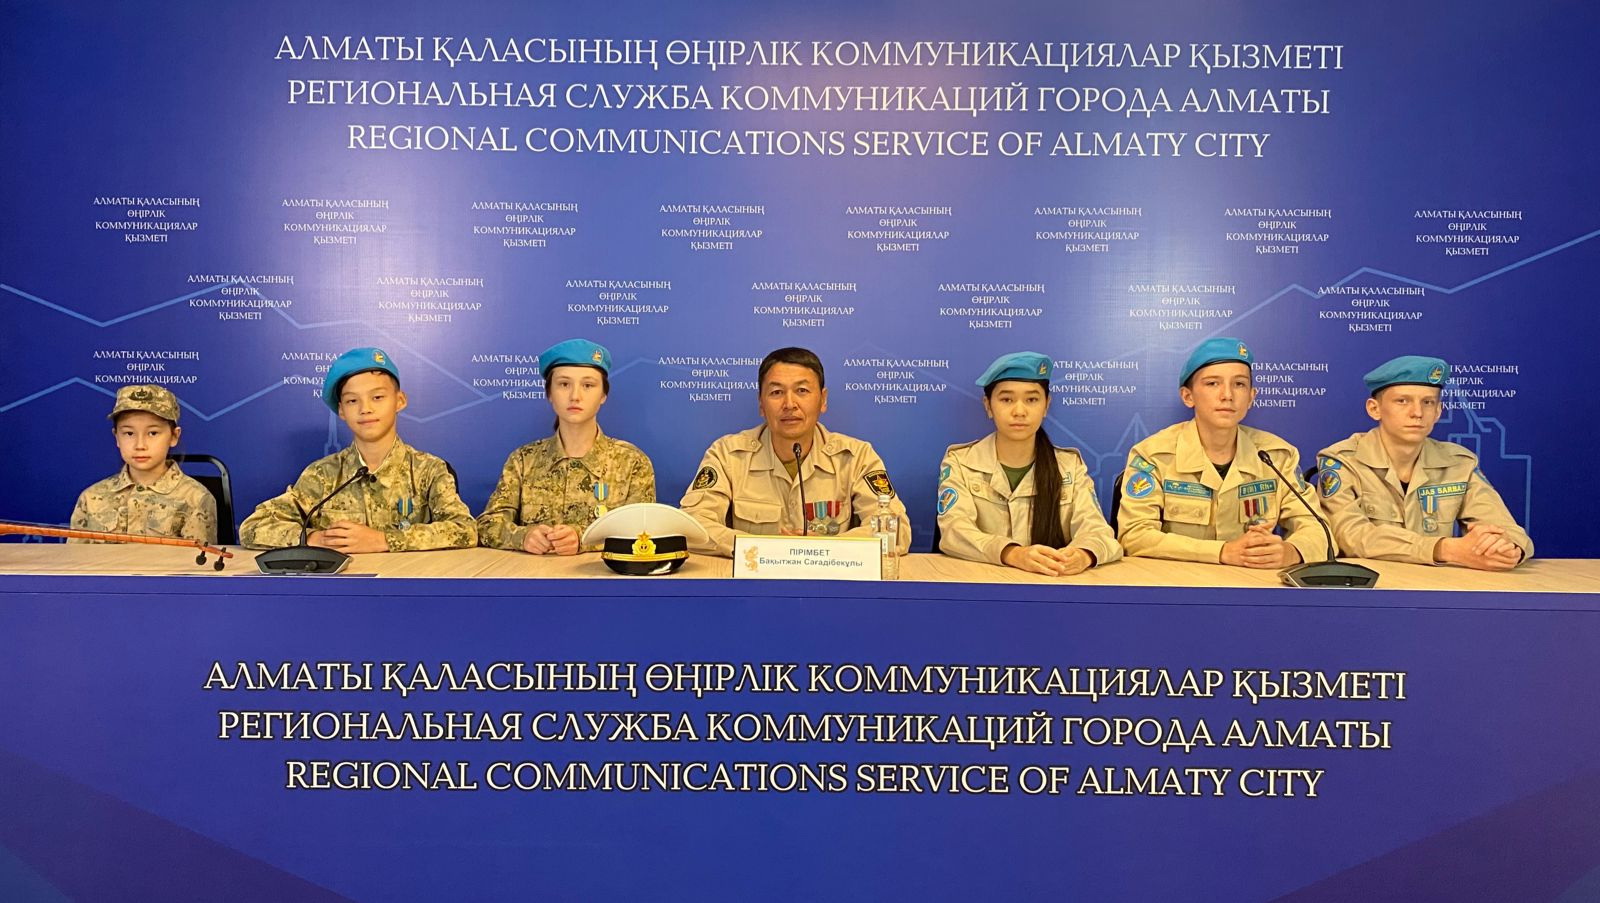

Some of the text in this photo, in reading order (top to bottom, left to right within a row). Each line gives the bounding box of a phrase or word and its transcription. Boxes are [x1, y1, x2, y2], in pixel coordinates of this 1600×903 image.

[274, 36, 1343, 74] АЛМАТЫ ҚАЛАСЫНЫҢ ӨҢІРЛІК КОММУНИКАЦИЯЛАР ҚЫЗМЕТІ
[288, 80, 1330, 118] РЕГИОНАЛЬНАЯ СЛУЖБА КОММУНИКАЦИЙ ГОРОДА АЛМАТЫ
[348, 125, 1270, 158] REGIONAL COMMUNICATIONS SERVICE OF ALMATY CITY
[137, 198, 200, 208] ҚАЛАСЫНЫҢ
[325, 200, 388, 208] ҚАЛАСЫНЫҢ
[515, 202, 577, 212] ҚАЛАСЫНЫҢ
[702, 205, 764, 214] ҚАЛАСЫНЫҢ
[889, 207, 951, 216] ҚАЛАСЫНЫҢ
[1078, 208, 1141, 216] ҚАЛАСЫНЫҢ
[1268, 209, 1331, 218] ҚАЛАСЫНЫҢ
[127, 210, 165, 219] ӨҢІРЛІК
[316, 212, 354, 221] ӨҢІРЛІК
[1458, 211, 1521, 220] ҚАЛАСЫНЫҢ
[506, 215, 544, 224] ӨҢІРЛІК
[693, 218, 730, 227] ӨҢІРЛІК
[879, 219, 917, 228] ӨҢІРЛІК
[96, 222, 197, 230] КОММУНИКАЦИЯЛАР
[284, 224, 386, 232] КОММУНИКАЦИЯЛАР
[1068, 220, 1106, 229] ӨҢІРЛІК
[1258, 221, 1296, 230] ӨҢІРЛІК
[1448, 223, 1487, 232] ӨҢІРЛІК
[474, 227, 576, 236] КОММУНИКАЦИЯЛАР
[662, 230, 762, 238] КОММУНИКАЦИЯЛАР
[848, 231, 949, 240] КОММУНИКАЦИЯЛАР
[1036, 232, 1139, 240] КОММУНИКАЦИЯЛАР
[125, 234, 167, 243] ҚЫЗМЕТІ
[314, 236, 356, 245] ҚЫЗМЕТІ
[1227, 233, 1329, 242] КОММУНИКАЦИЯЛАР
[1416, 235, 1519, 244] КОММУНИКАЦИЯЛАР
[504, 239, 545, 248] ҚЫЗМЕТІ
[691, 242, 732, 251] ҚЫЗМЕТІ
[877, 244, 919, 253] ҚЫЗМЕТІ
[1066, 244, 1108, 253] ҚЫЗМЕТІ
[1256, 246, 1298, 255] ҚЫЗМЕТІ
[1446, 248, 1488, 257] ҚЫЗМЕТІ
[231, 276, 293, 284] ҚАЛАСЫНЫҢ
[420, 278, 483, 288] ҚАЛАСЫНЫҢ
[609, 281, 671, 290] ҚАЛАСЫНЫҢ
[794, 283, 856, 292] ҚАЛАСЫНЫҢ
[981, 284, 1044, 294] ҚАЛАСЫНЫҢ
[1172, 285, 1235, 294] ҚАЛАСЫНЫҢ
[222, 288, 260, 297] ӨҢІРЛІК
[411, 290, 449, 299] ӨҢІРЛІК
[1361, 287, 1424, 296] ҚАЛАСЫНЫҢ
[599, 293, 637, 302] ӨҢІРЛІК
[785, 295, 822, 304] ӨҢІРЛІК
[972, 296, 1010, 305] ӨҢІРЛІК
[1162, 297, 1200, 306] ӨҢІРЛІК
[190, 300, 291, 308] КОММУНИКАЦИЯЛАР
[379, 302, 481, 310] КОММУНИКАЦИЯЛАР
[1352, 300, 1390, 308] ӨҢІРЛІК
[568, 305, 669, 314] КОММУНИКАЦИЯЛАР
[754, 307, 854, 316] КОММУНИКАЦИЯЛАР
[940, 308, 1042, 316] КОММУНИКАЦИЯЛАР
[1130, 310, 1233, 318] КОММУНИКАЦИЯЛАР
[219, 312, 261, 321] ҚЫЗМЕТІ
[408, 314, 451, 323] ҚЫЗМЕТІ
[597, 317, 639, 326] ҚЫЗМЕТІ
[783, 319, 824, 328] ҚЫЗМЕТІ
[969, 321, 1011, 329] ҚЫЗМЕТІ
[1160, 322, 1202, 331] ҚЫЗМЕТІ
[1349, 324, 1391, 333] ҚЫЗМЕТІ
[136, 351, 199, 360] ҚАЛАСЫНЫҢ
[127, 364, 164, 372] ӨҢІРЛІК
[886, 359, 948, 368] ҚАЛАСЫНЫҢ
[1075, 362, 1138, 370] ҚАЛАСЫНЫҢ
[1266, 364, 1328, 372] ҚАЛАСЫНЫҢ
[692, 370, 729, 379] ӨҢІРЛІК
[1455, 366, 1519, 374] ҚАЛАСЫНЫҢ
[877, 372, 914, 380] ӨҢІРЛІК
[1065, 373, 1104, 382] ӨҢІРЛІК
[1256, 376, 1294, 384] ӨҢІРЛІК
[474, 379, 546, 388] КОММУНИКАЦ
[690, 394, 731, 402] ҚЫЗМЕТІ
[875, 396, 916, 405] ҚЫЗМЕТІ
[1062, 398, 1106, 407] ҚЫЗМЕТІ
[1253, 400, 1296, 409] ҚЫЗМЕТІ
[789, 548, 830, 556] ПІРІМБЕТ
[759, 557, 802, 566] Бақытжан
[204, 662, 1406, 704] АЛМАТЫ ҚАЛАСЫНЫҢ ӨҢІРЛІК КОММУНИКАЦИЯЛАР ҚЫЗМЕТІ
[219, 711, 1391, 752] РЕГИОНАЛЬНАЯ СЛУЖБА КОММУНИКАЦИЙ ГОРОДА АЛМАТЫ
[286, 760, 1324, 797] REGIONAL COMMUNICATIONS SERVICE OF ALMATY CITY
